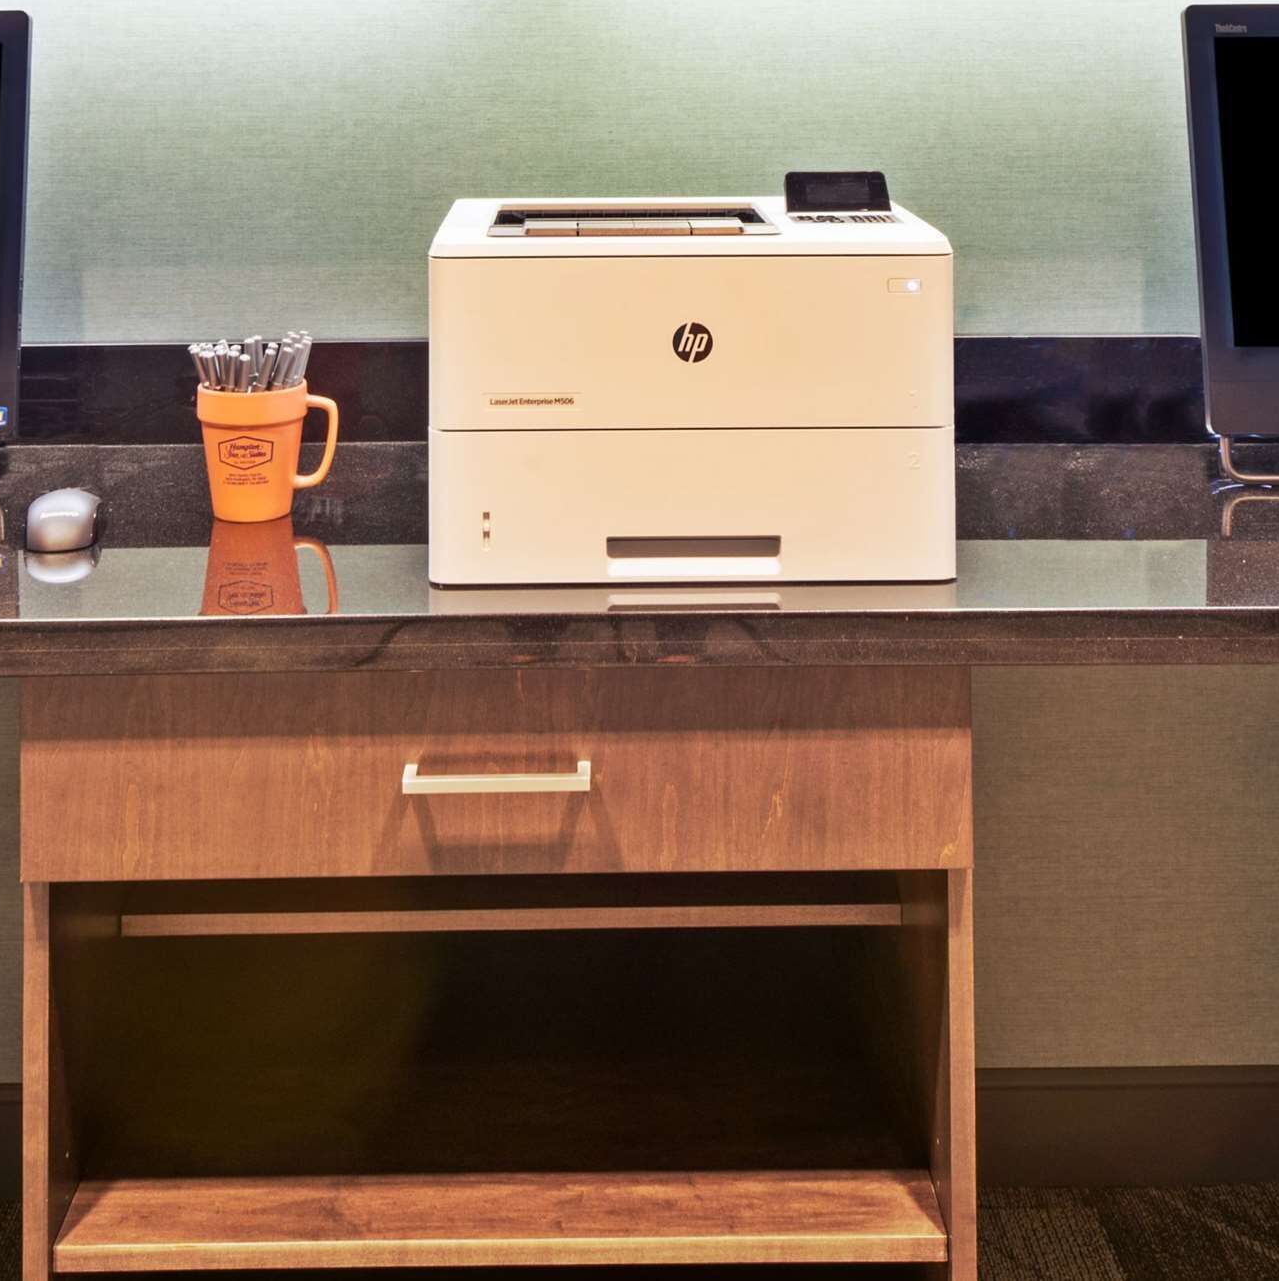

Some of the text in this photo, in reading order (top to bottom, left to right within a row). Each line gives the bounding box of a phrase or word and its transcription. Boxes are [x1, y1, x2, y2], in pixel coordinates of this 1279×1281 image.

[675, 322, 710, 363] hp
[489, 397, 575, 406] LaserJet Enterprise M506
